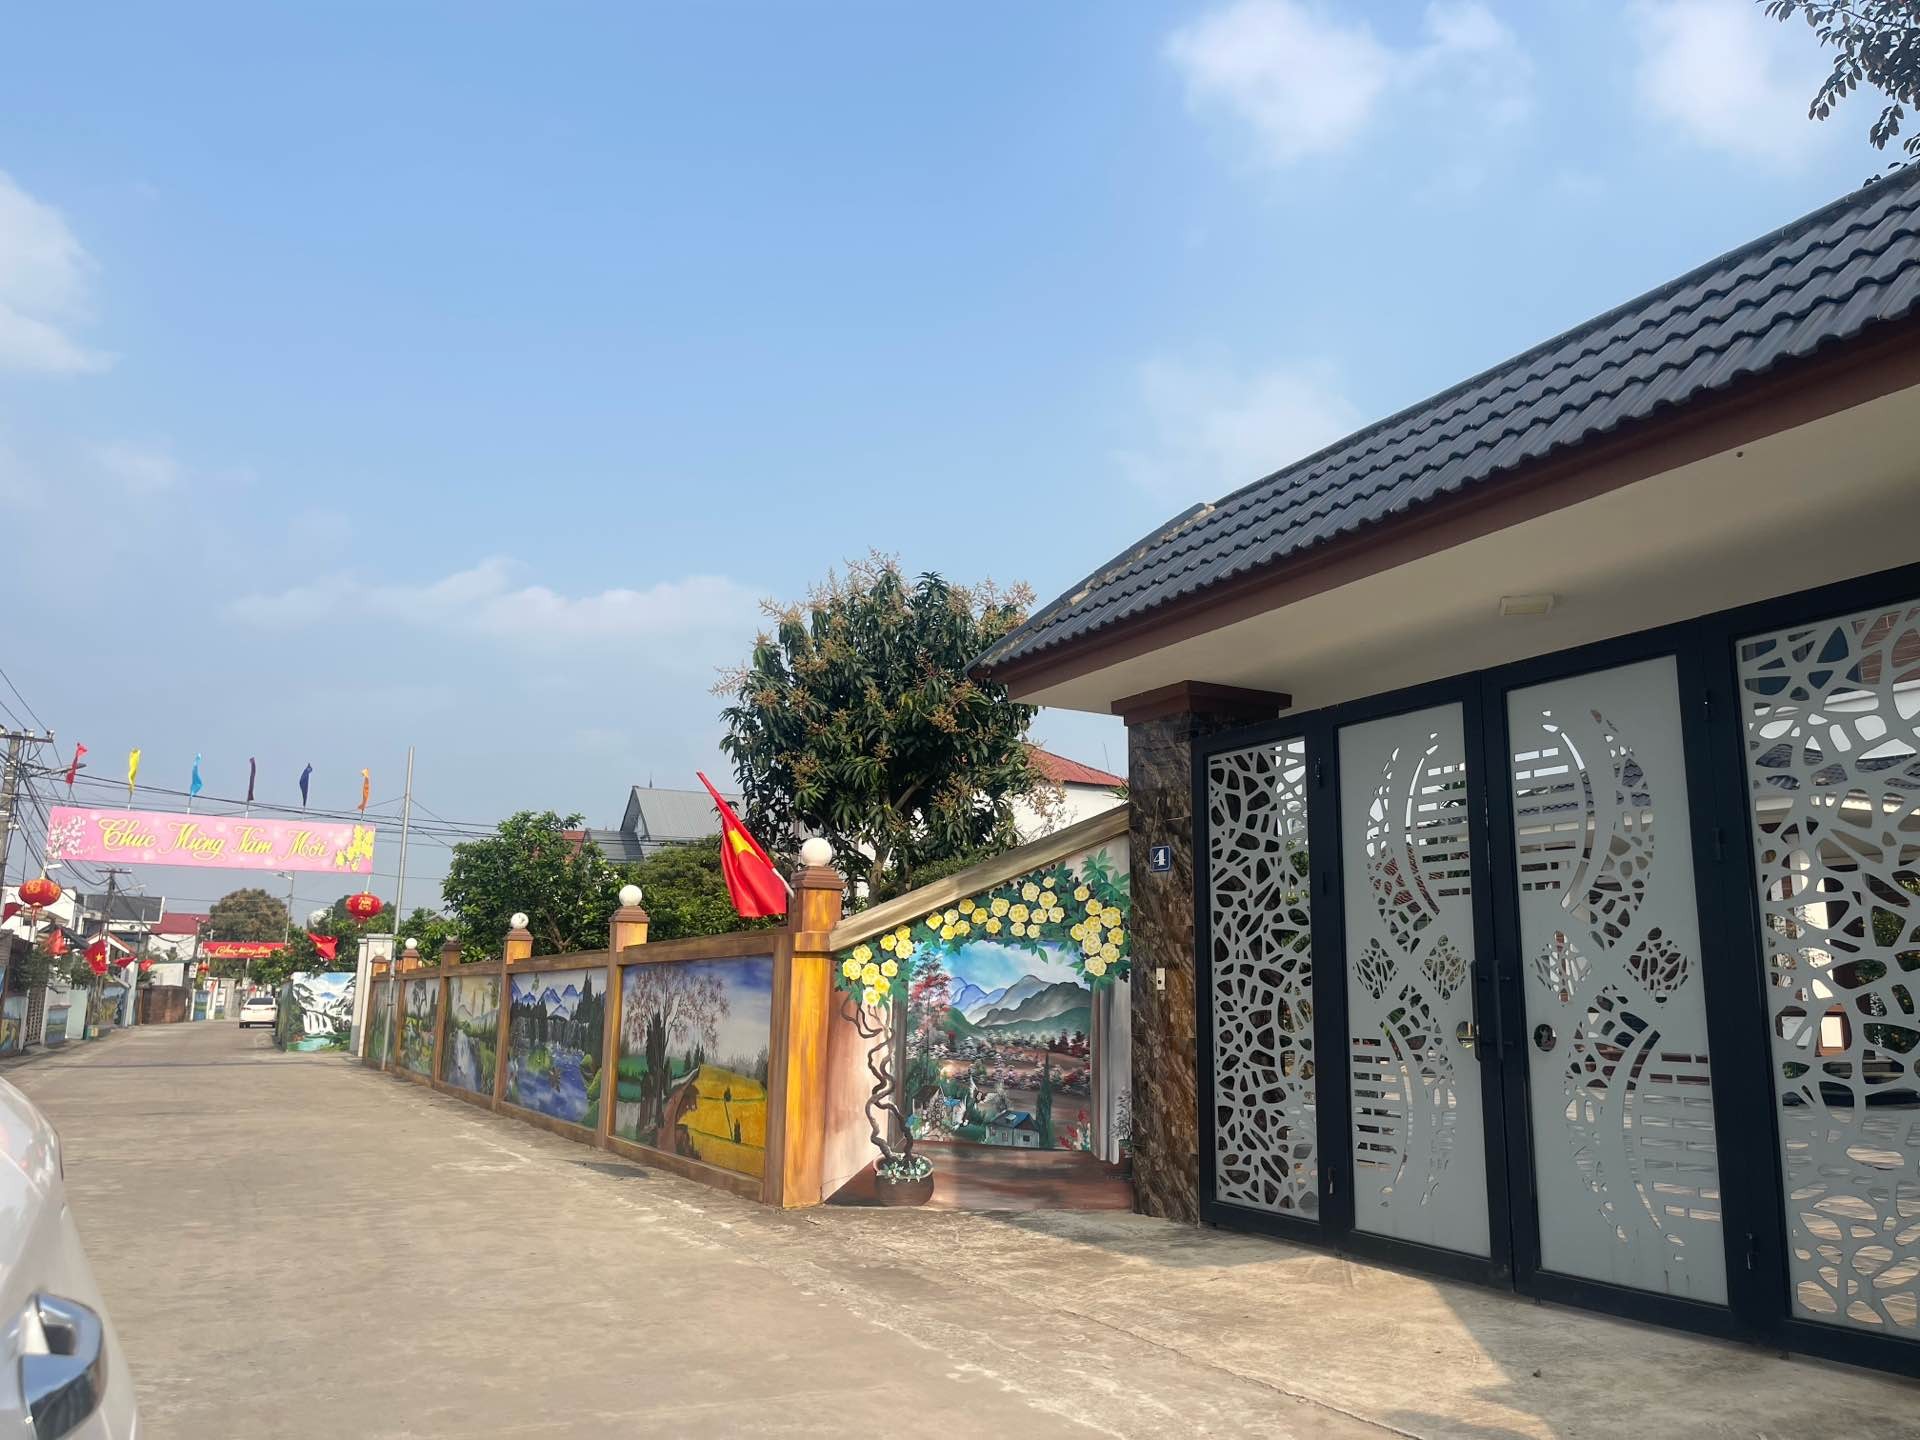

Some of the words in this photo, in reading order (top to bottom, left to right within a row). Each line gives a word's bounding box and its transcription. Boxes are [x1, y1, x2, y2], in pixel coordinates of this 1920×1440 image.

[98, 818, 157, 851] Chúc
[158, 822, 227, 862] Mừng
[276, 829, 331, 862] Mới
[1153, 848, 1166, 867] 4
